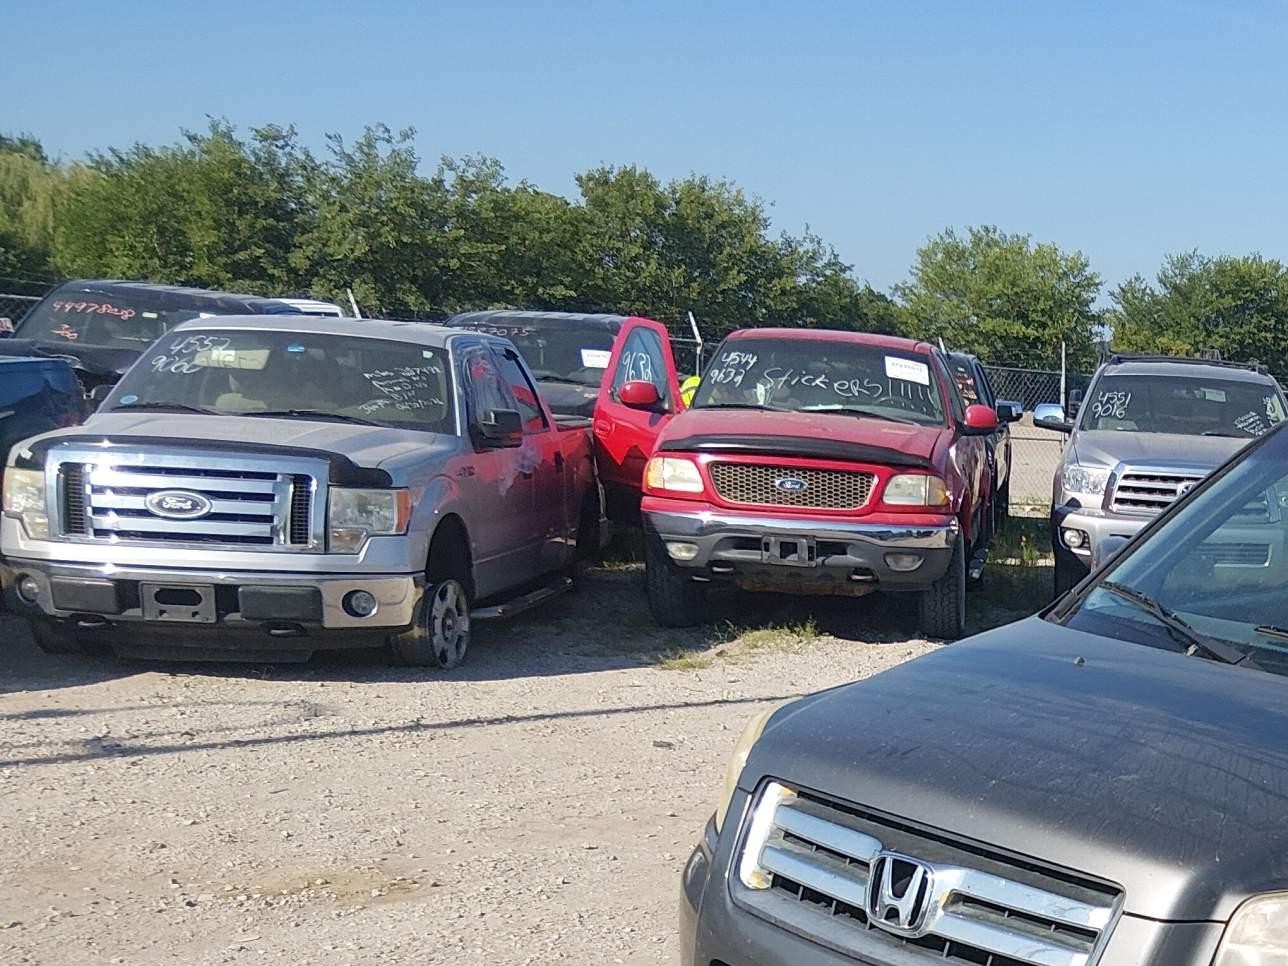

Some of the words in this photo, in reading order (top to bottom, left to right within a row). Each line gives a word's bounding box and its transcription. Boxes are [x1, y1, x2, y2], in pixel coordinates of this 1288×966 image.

[721, 352, 757, 370] 4544
[1098, 392, 1131, 406] 4551
[1092, 402, 1127, 419] 9016
